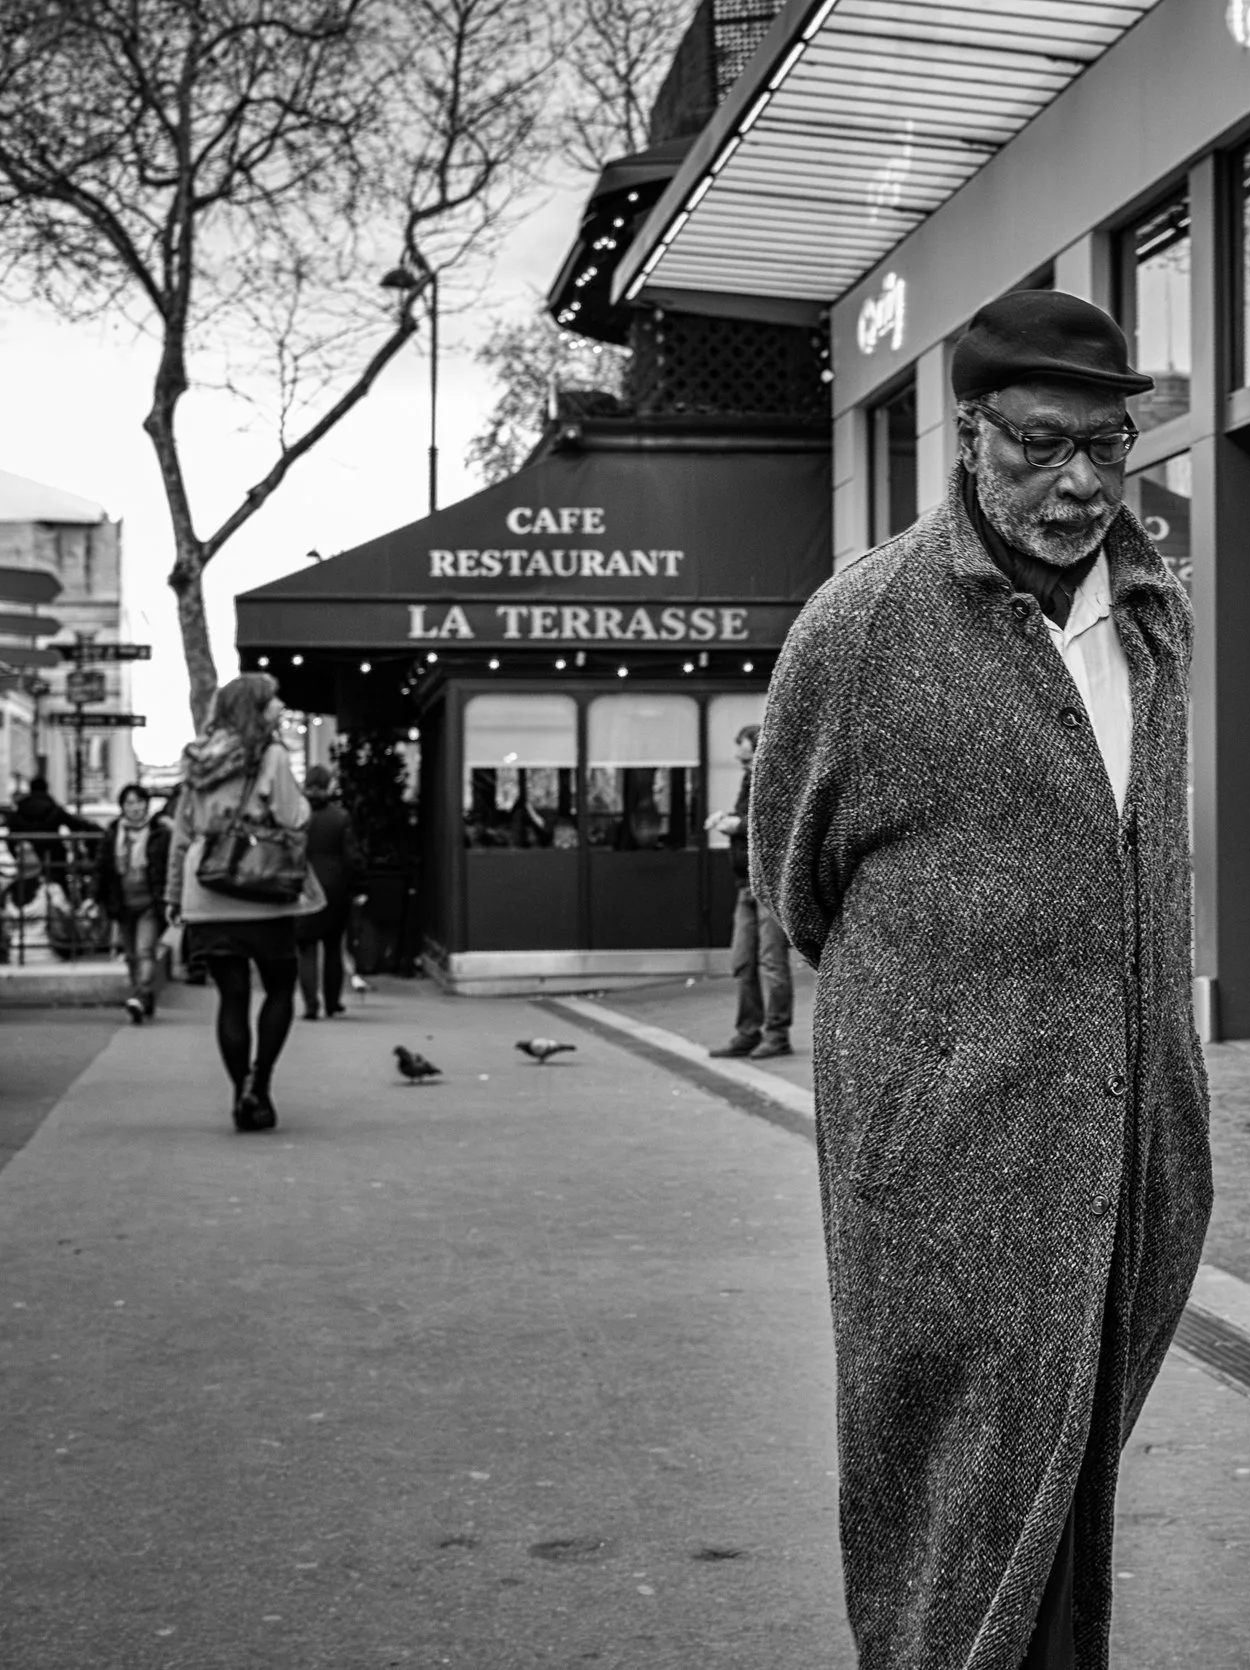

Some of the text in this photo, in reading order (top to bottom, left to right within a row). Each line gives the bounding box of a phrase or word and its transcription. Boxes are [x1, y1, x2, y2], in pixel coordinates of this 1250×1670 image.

[506, 506, 606, 535] CAFE
[428, 549, 684, 578] RESTAURANT
[407, 604, 749, 641] LA TERRASSE
